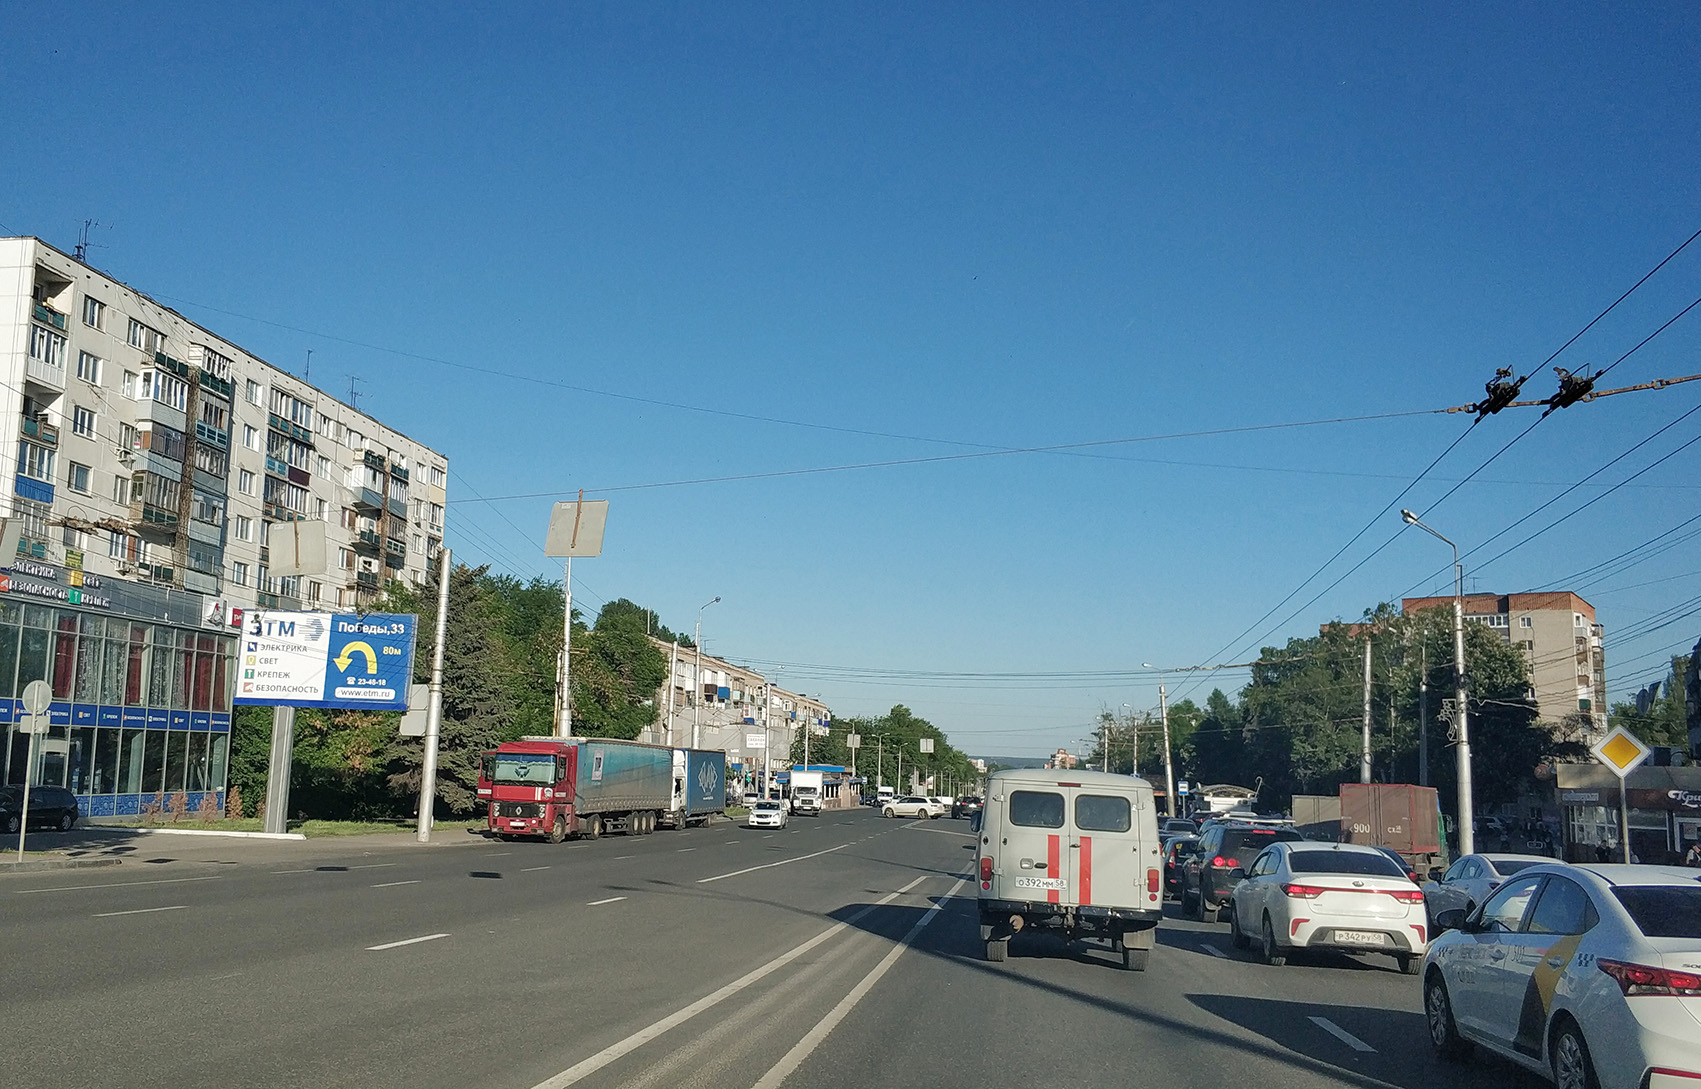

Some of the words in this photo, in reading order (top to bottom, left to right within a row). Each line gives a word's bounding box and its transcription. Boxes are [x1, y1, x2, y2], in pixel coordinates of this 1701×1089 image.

[249, 619, 296, 637] ЭТМ
[338, 621, 405, 635] Победы,33
[260, 643, 308, 653] ЭЛЕКТРИКА
[382, 646, 402, 656] 80м
[258, 657, 279, 665] СВЕТ
[257, 670, 291, 679] КРЕПЕЖ
[255, 684, 319, 694] БЕЗОПАСНОСТЬ
[340, 689, 391, 698] www.etm.ru
